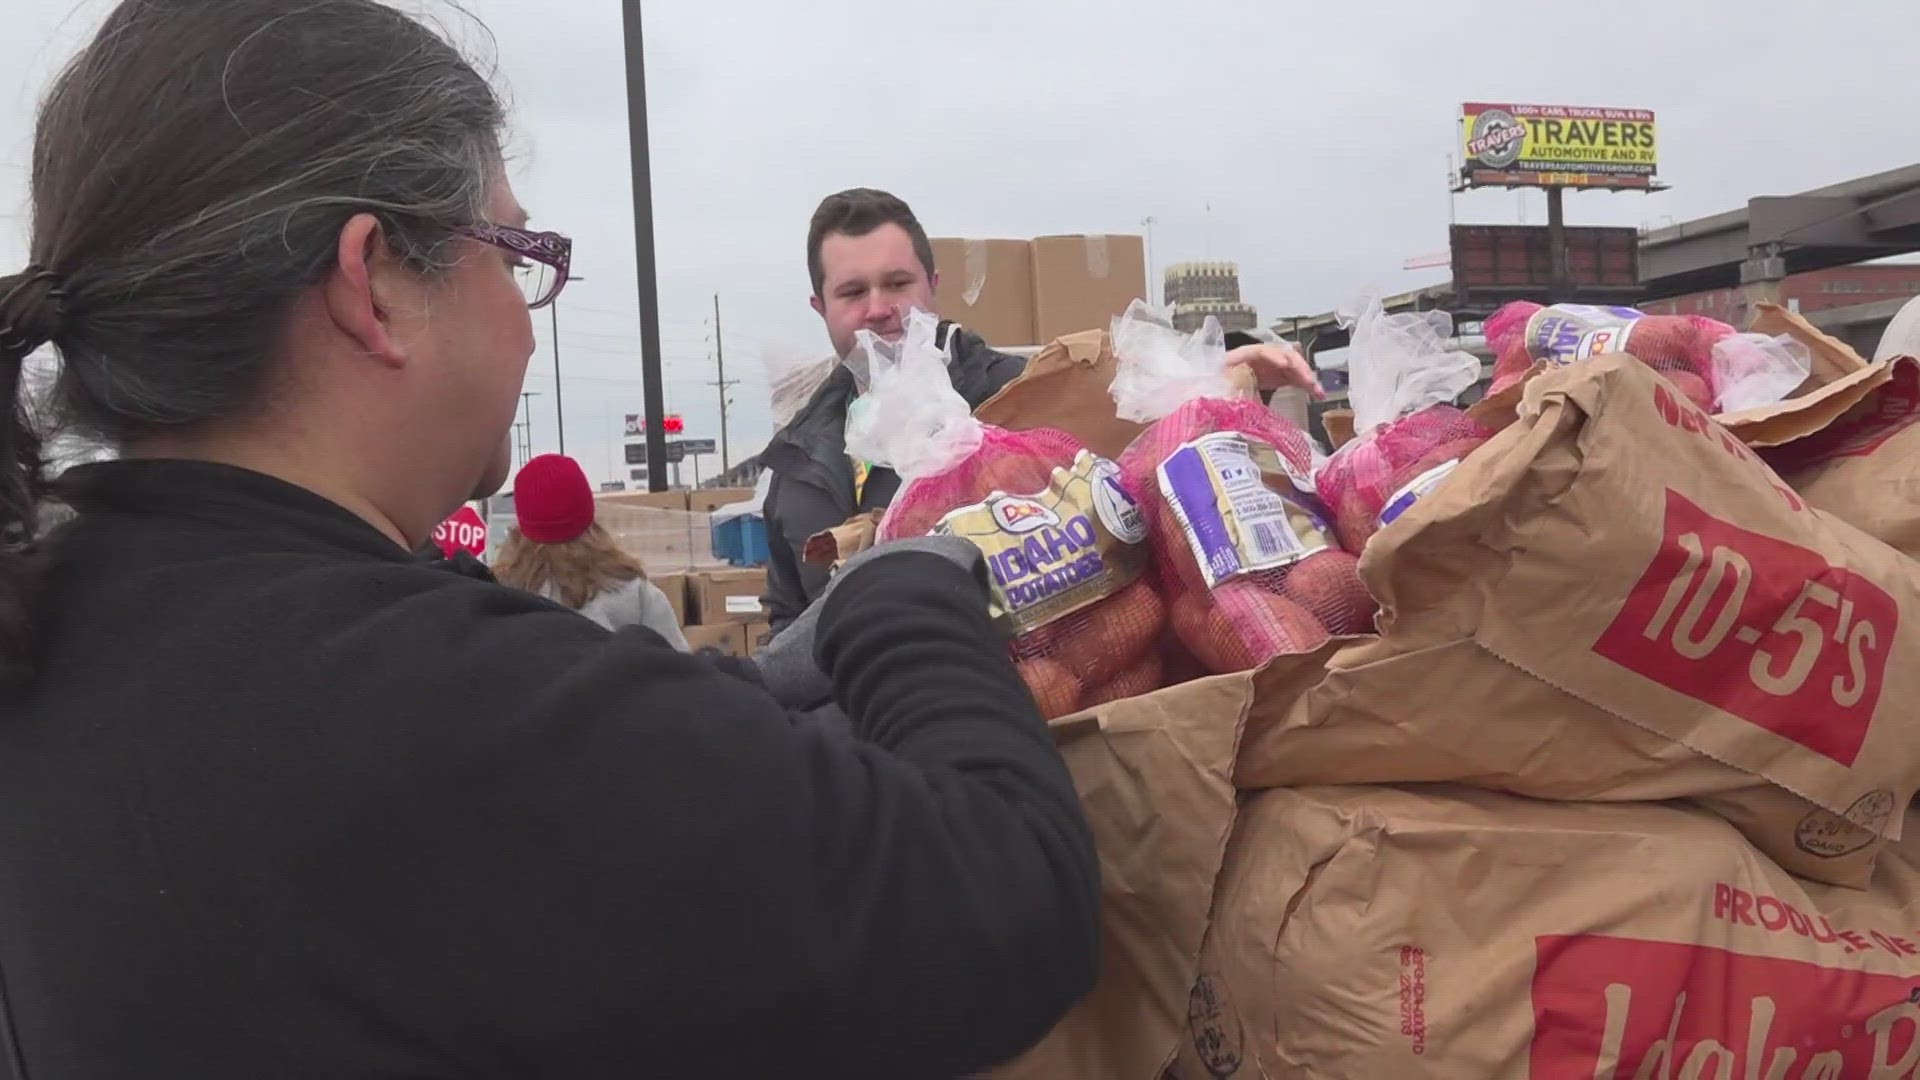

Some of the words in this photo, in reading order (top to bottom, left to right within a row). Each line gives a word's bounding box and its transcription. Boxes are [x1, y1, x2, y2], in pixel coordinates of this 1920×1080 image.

[1467, 123, 1526, 155] TRAVERS
[1526, 119, 1654, 148] TRAVERS
[1530, 147, 1607, 160] AUTOMOTIVE
[1611, 149, 1636, 161] AND
[1640, 150, 1655, 161] RV
[434, 520, 485, 548] STOP
[987, 515, 1096, 586] IDAHO
[1004, 551, 1104, 610] POTATOES
[1713, 882, 1875, 955] PRODUE
